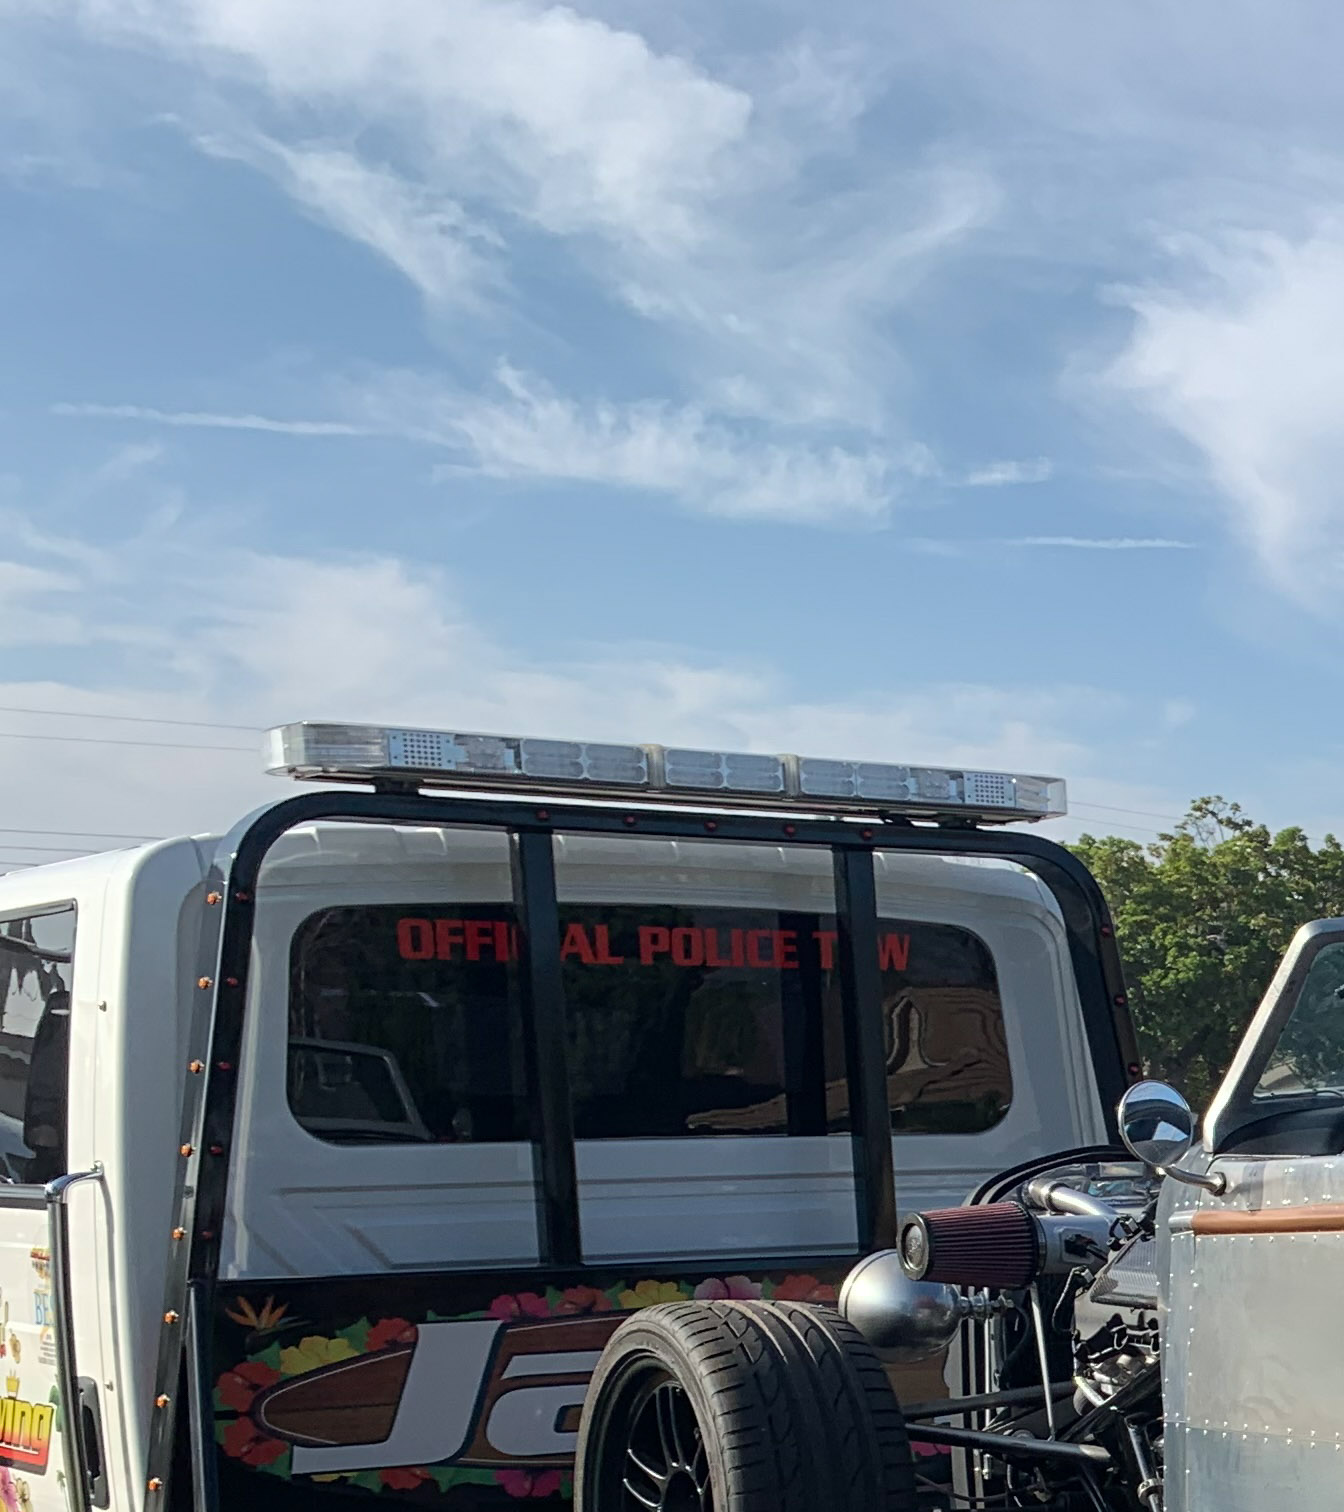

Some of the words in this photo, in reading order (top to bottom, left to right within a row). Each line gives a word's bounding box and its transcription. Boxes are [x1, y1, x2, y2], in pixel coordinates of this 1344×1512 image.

[396, 918, 623, 964] OFFIAL
[639, 926, 799, 970] POLICE
[812, 930, 910, 972] TW
